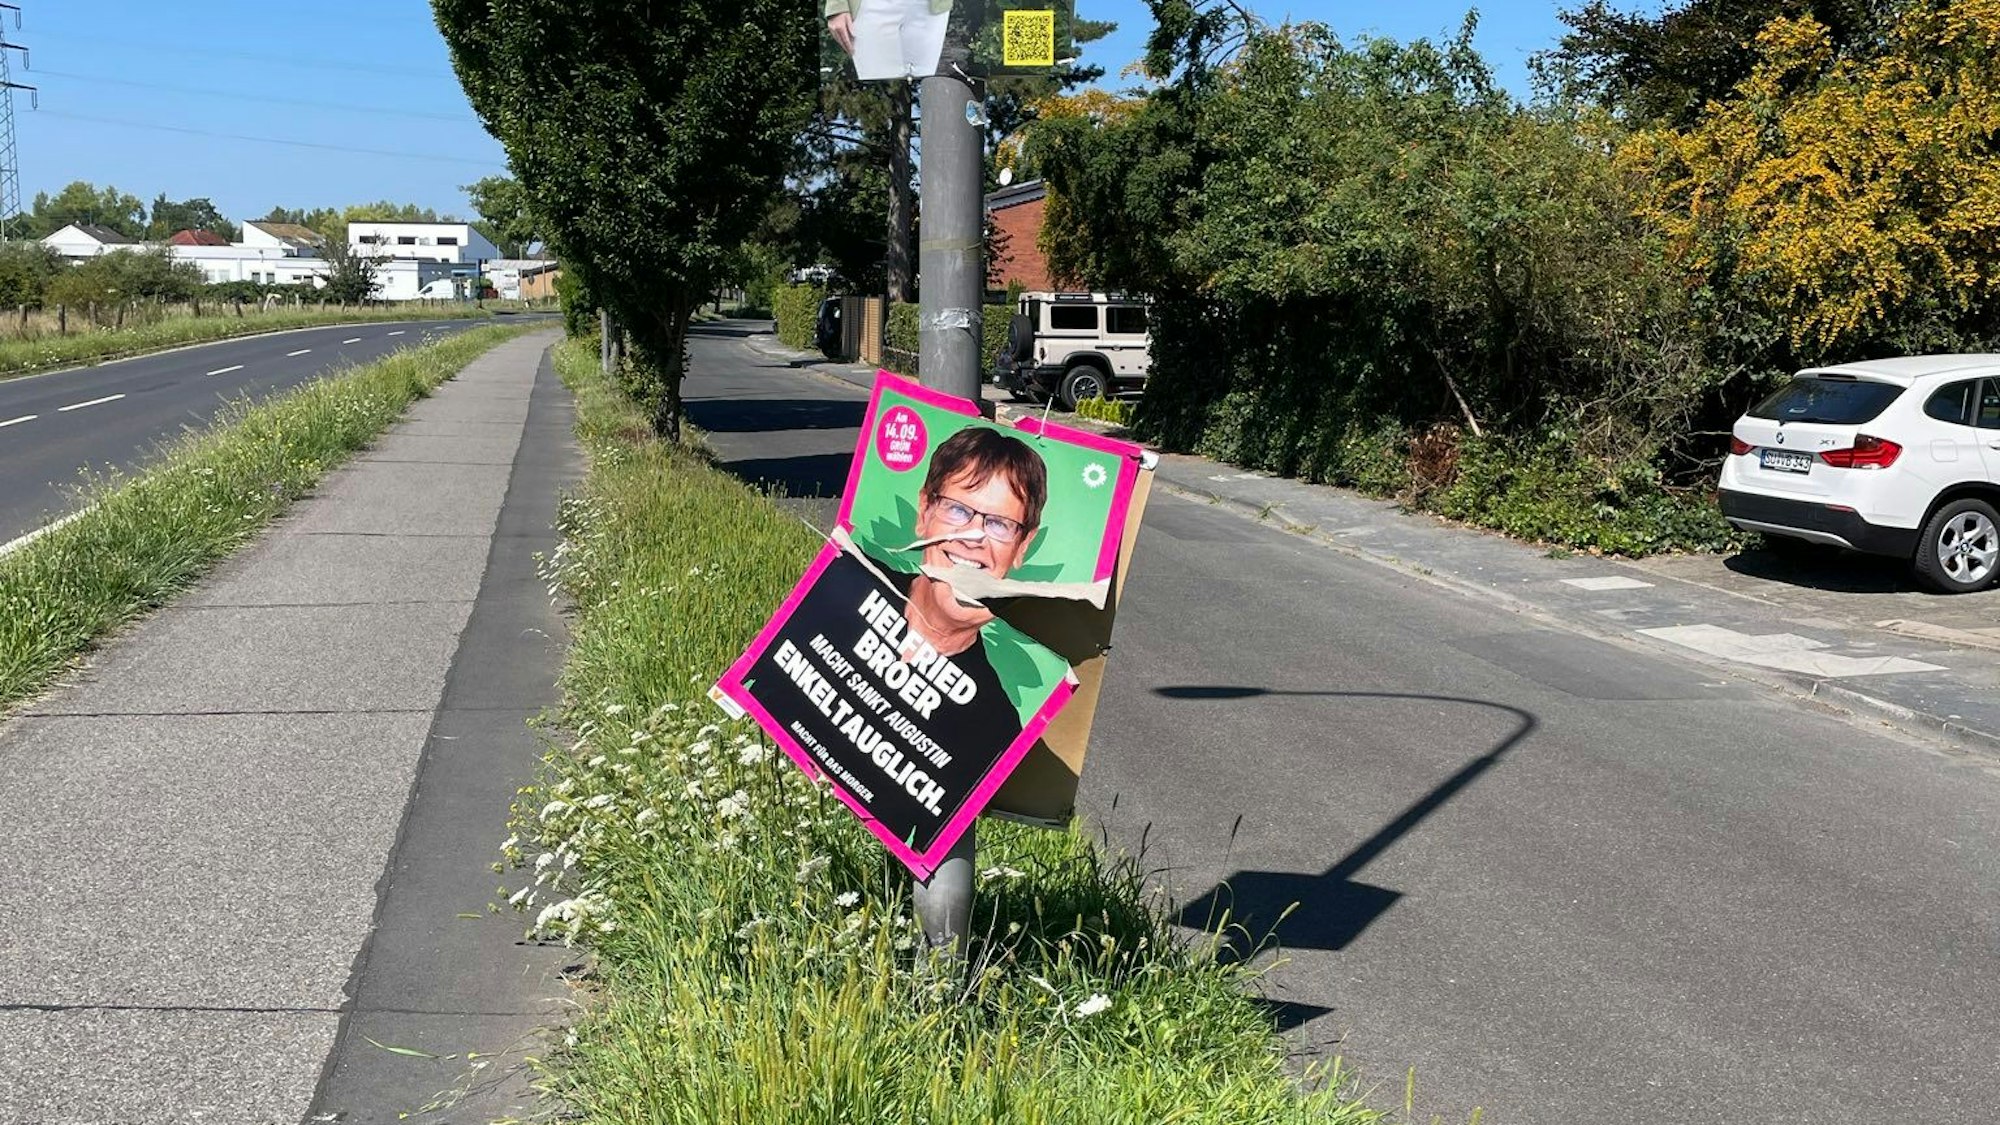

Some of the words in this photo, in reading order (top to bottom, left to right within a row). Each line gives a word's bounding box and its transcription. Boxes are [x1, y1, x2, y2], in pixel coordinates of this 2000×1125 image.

[885, 423, 918, 441] 14.09.
[895, 412, 908, 423] Am
[853, 628, 942, 720] BROER
[858, 588, 977, 705] HELFRIED
[773, 639, 946, 817] ENKELTAUGLICH.
[809, 633, 855, 678] MACHT
[846, 673, 892, 714] SANKT
[883, 710, 953, 769] AUGUSTIN
[790, 720, 818, 747] MACHT
[812, 743, 830, 762] FÜR
[825, 757, 844, 775] DAS
[839, 770, 875, 803] MORGEN.
